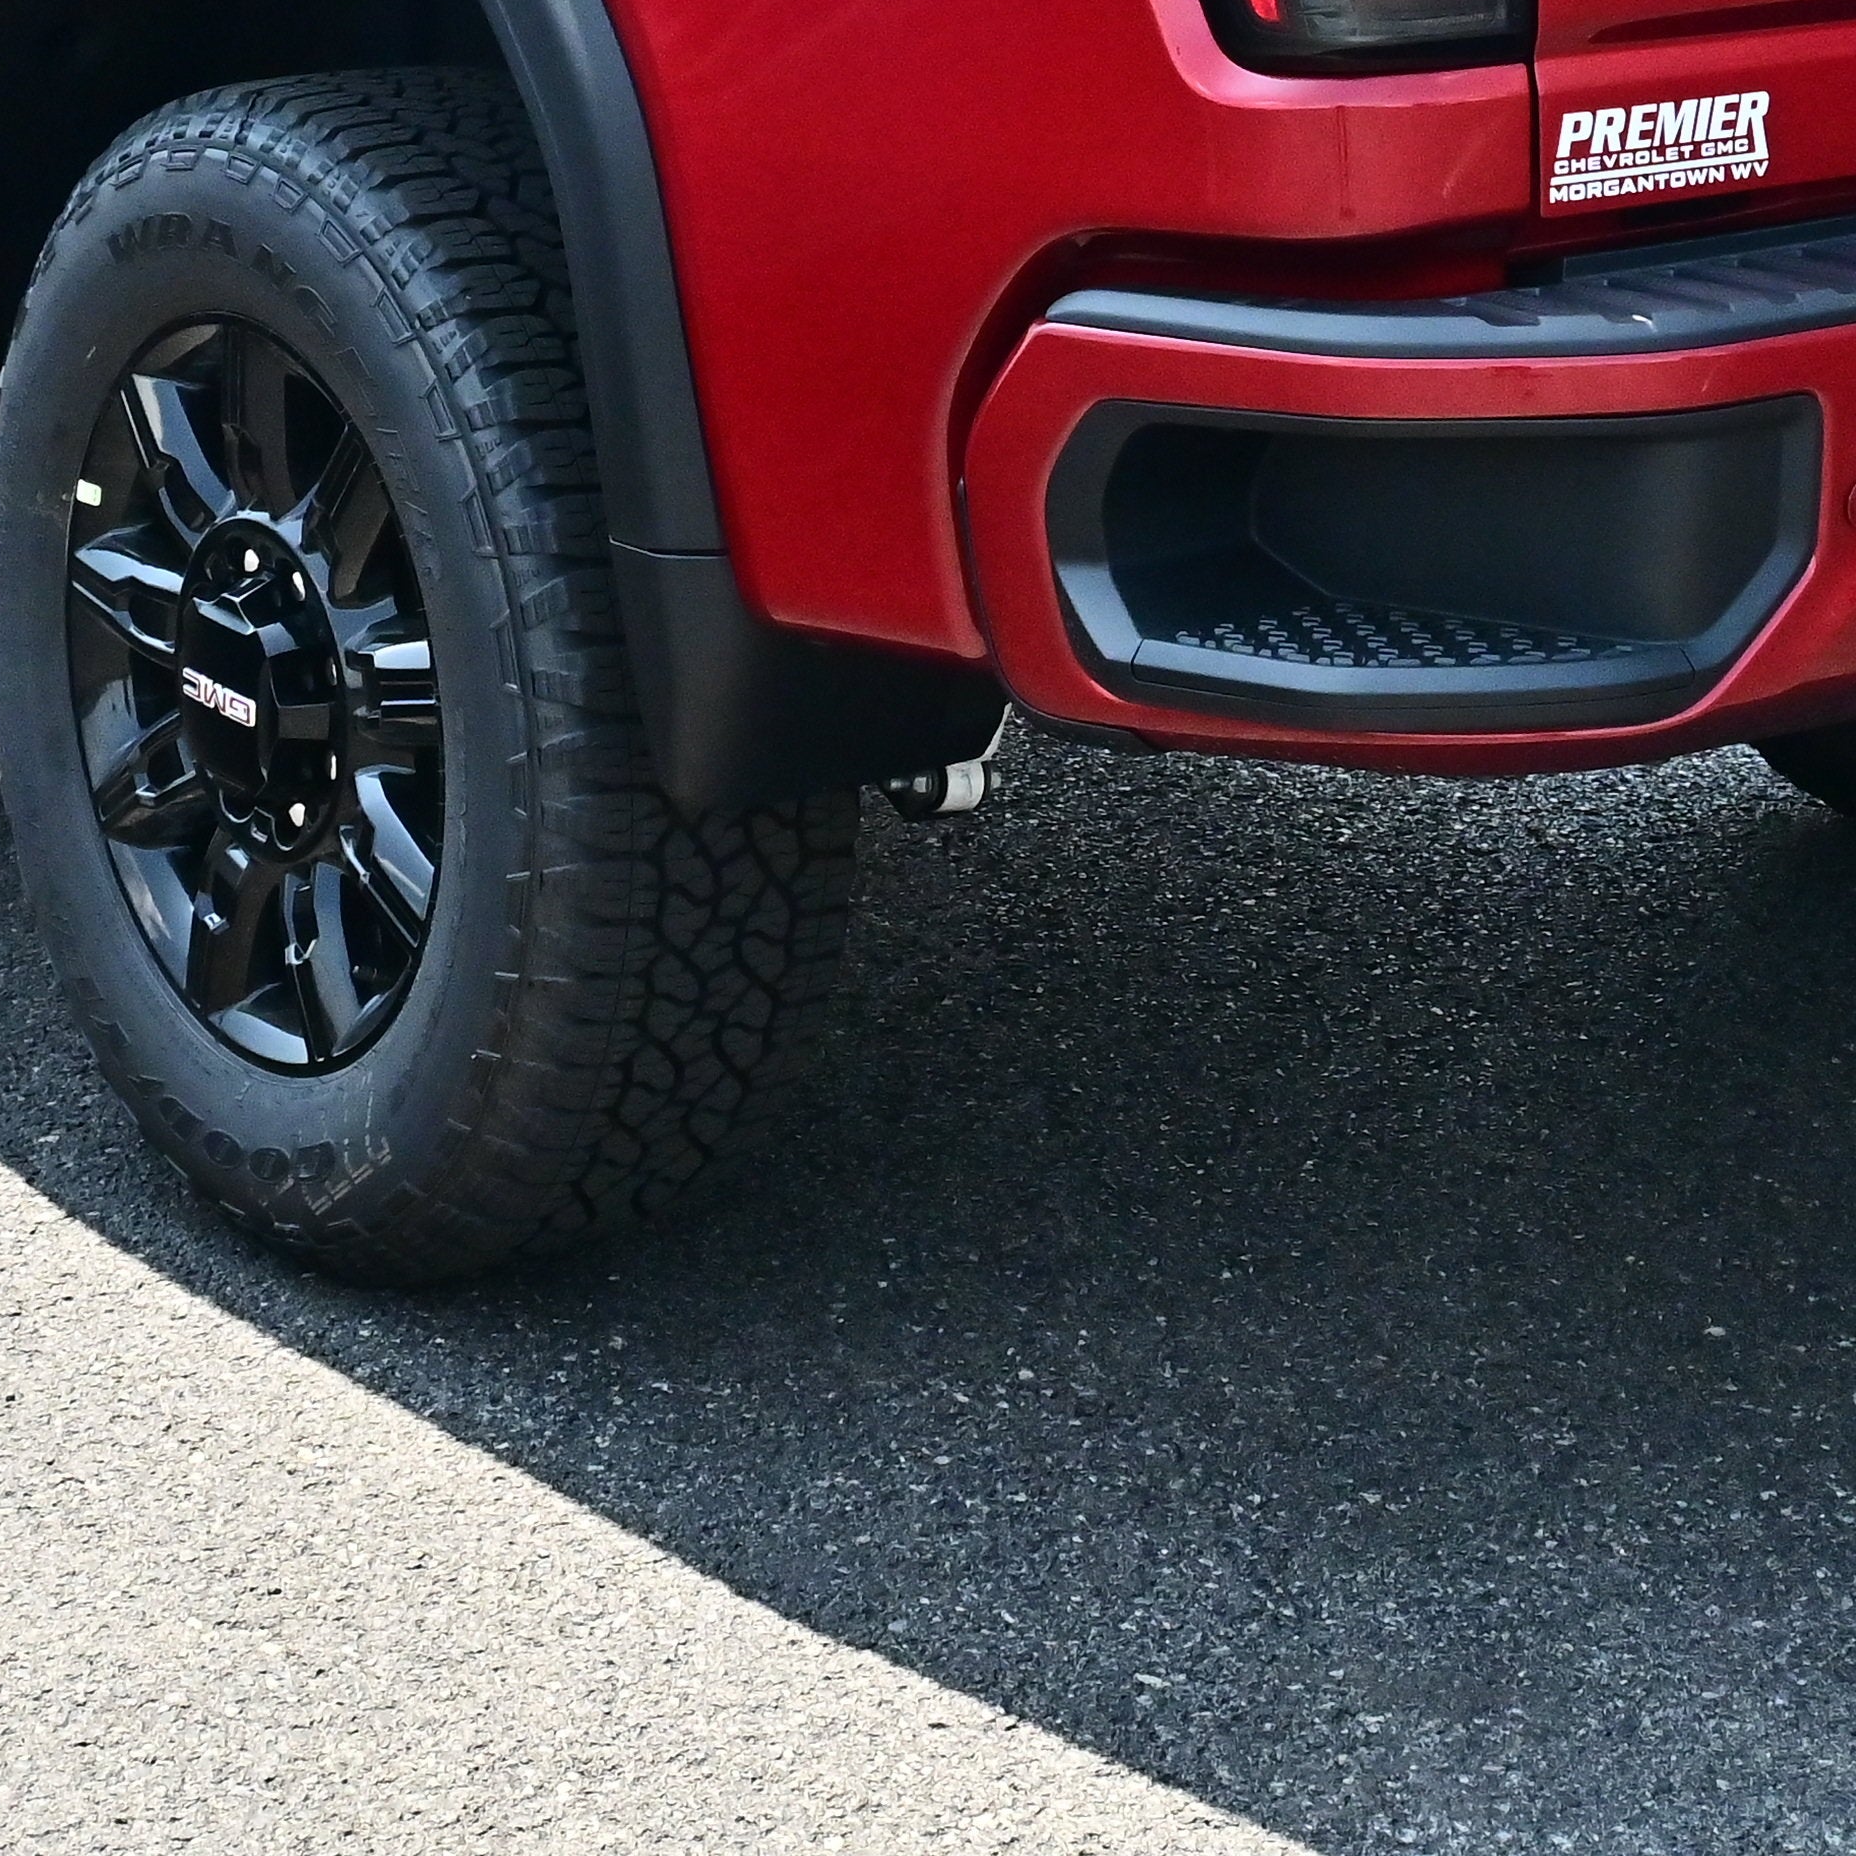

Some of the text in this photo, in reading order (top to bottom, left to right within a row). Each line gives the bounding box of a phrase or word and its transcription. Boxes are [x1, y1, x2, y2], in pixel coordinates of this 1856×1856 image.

[1555, 90, 1771, 160] PREMIER
[1548, 159, 1770, 205] MORGANTOWN WV
[1553, 137, 1750, 176] CHEVROLET GMC
[181, 666, 258, 729] GMC
